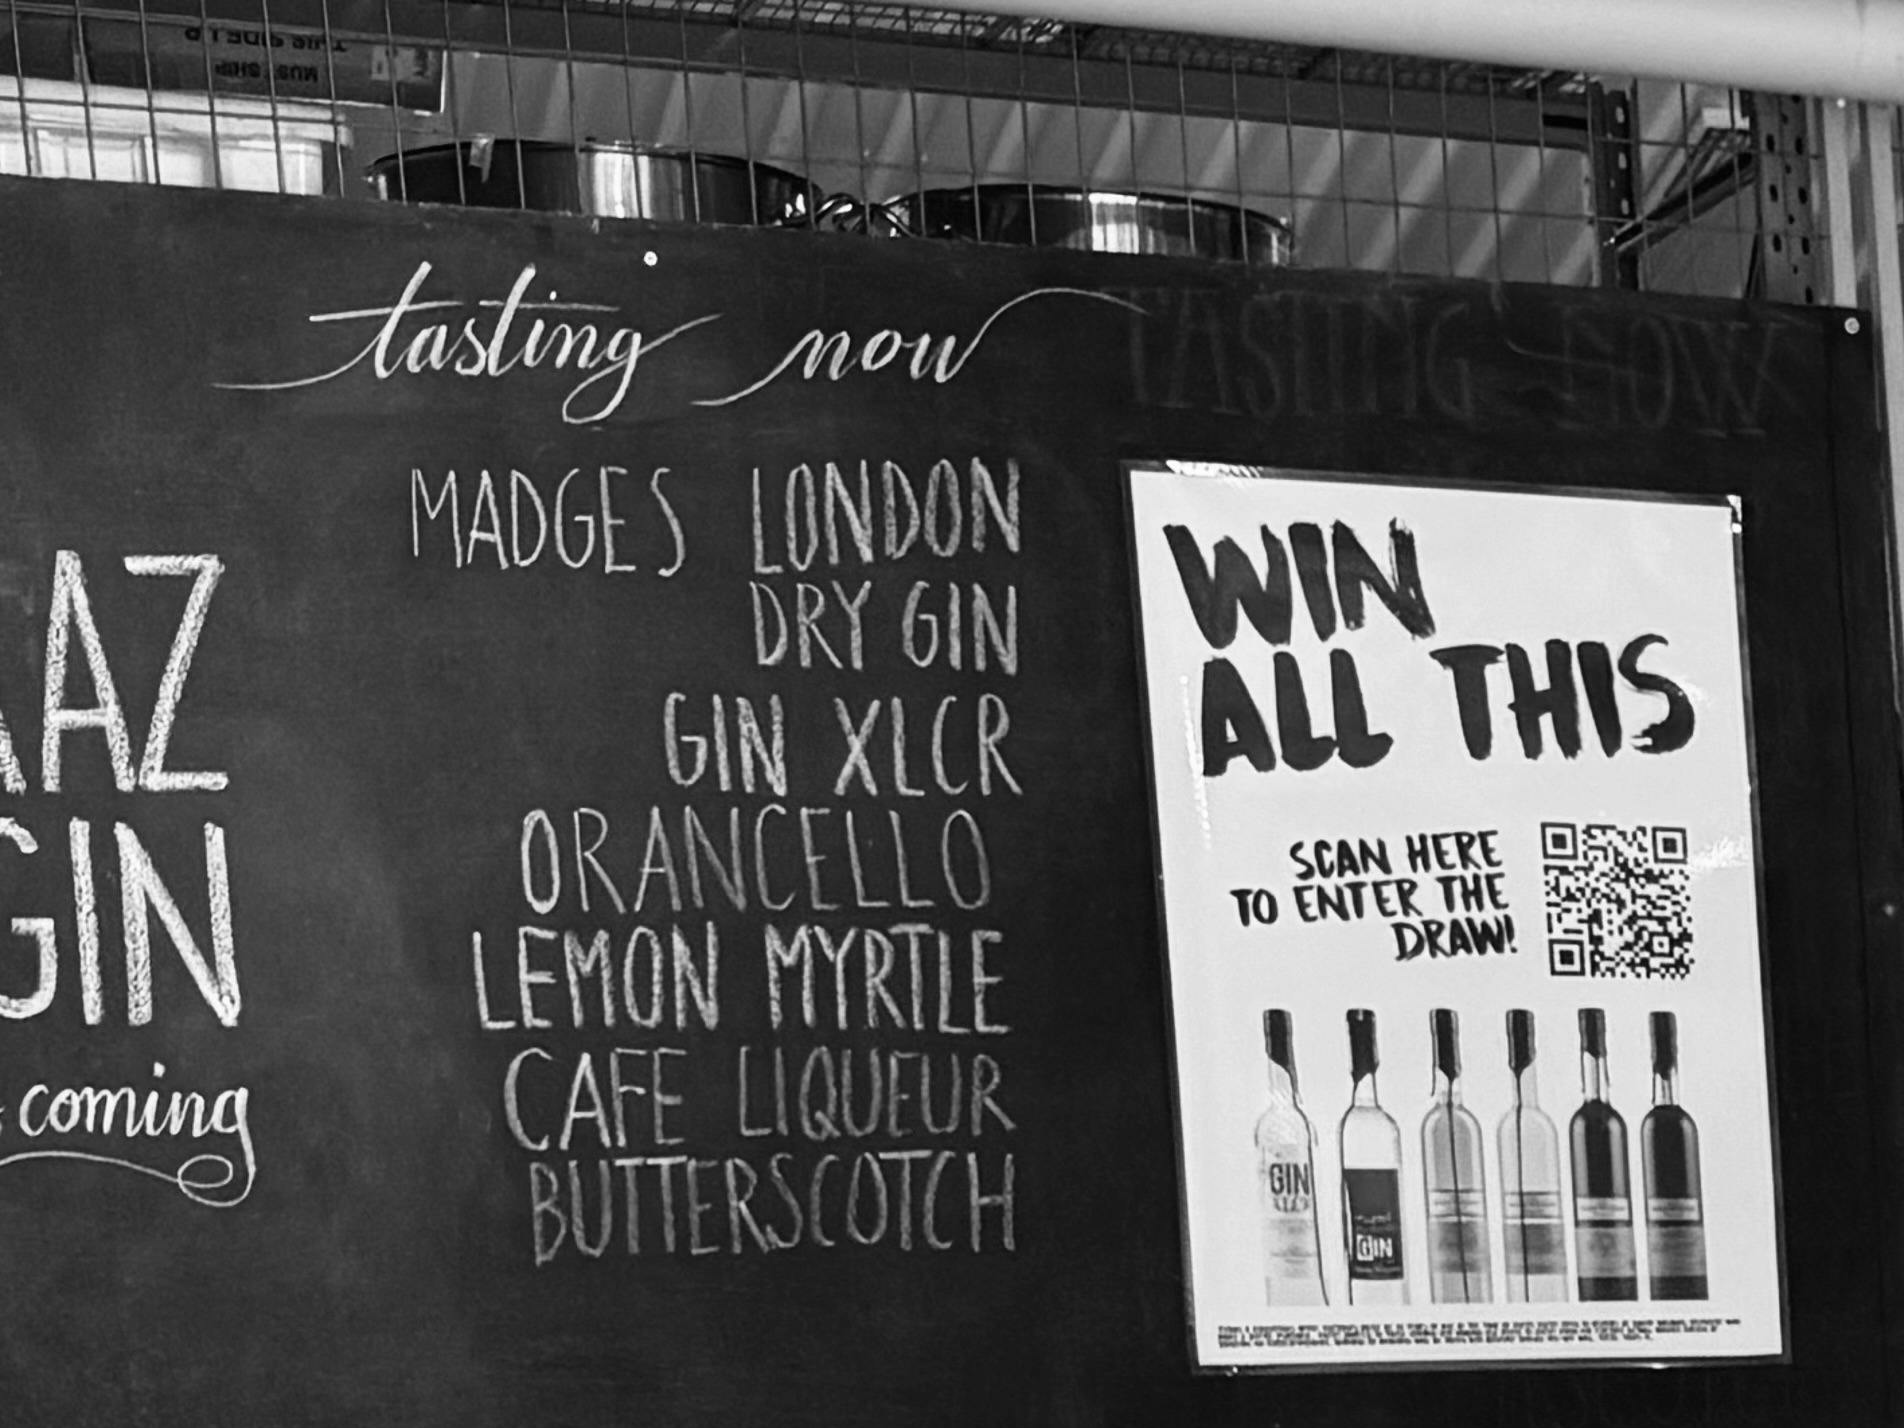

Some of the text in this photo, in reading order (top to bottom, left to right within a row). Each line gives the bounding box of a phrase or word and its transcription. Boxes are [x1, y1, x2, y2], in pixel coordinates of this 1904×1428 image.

[264, 65, 317, 82] MUS
[214, 261, 722, 423] tasting
[411, 456, 1020, 578] MADGES LONDON
[748, 579, 1018, 676] DRY GIN
[1162, 517, 1436, 650] WIN
[0, 550, 227, 793] AZ
[1200, 633, 1696, 778] ALL THIS
[663, 691, 1023, 798] GIN XLCR
[519, 802, 989, 916] ORANCELLO
[1229, 872, 1510, 927] TO ENTER THE
[1289, 829, 1503, 881] SCAN HERE
[0, 817, 241, 1027] GIN
[472, 920, 1009, 1034] LEMON MYRTLE
[1390, 913, 1518, 962] DRAW!
[18, 1060, 257, 1208] coming
[503, 1044, 1017, 1152] CAFE LIQUEUR
[528, 1148, 1015, 1268] BUTTERSCOTCH
[1269, 1163, 1310, 1196] GIN
